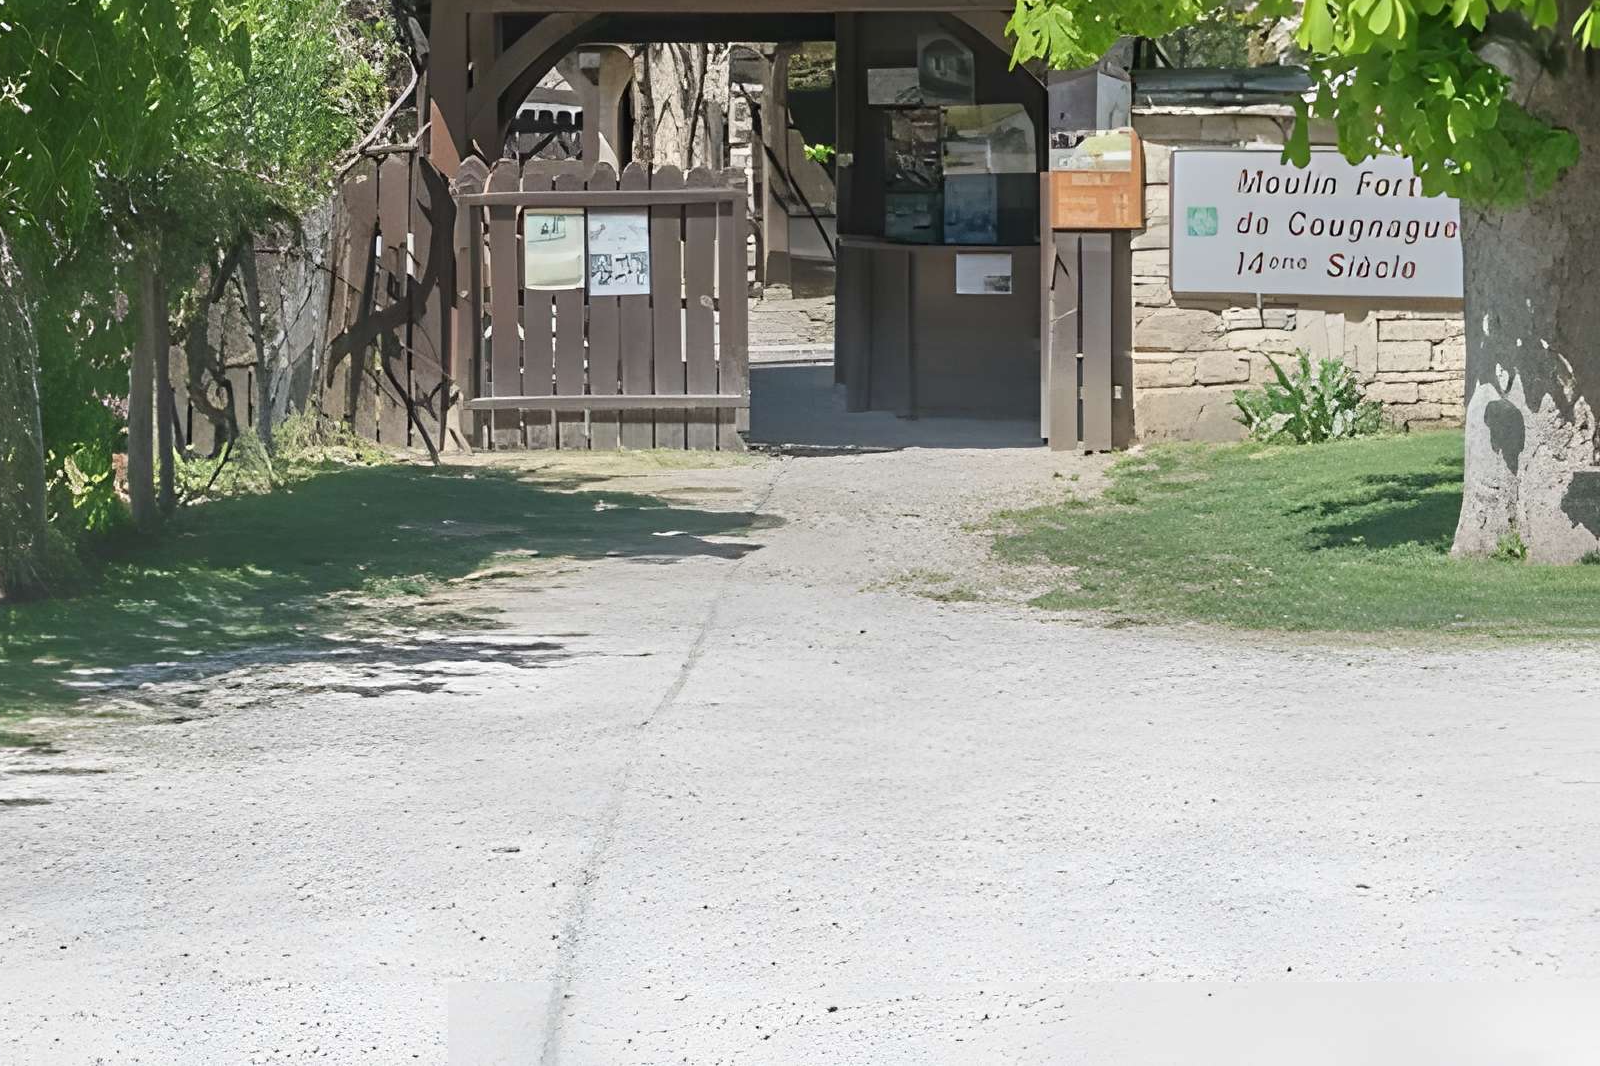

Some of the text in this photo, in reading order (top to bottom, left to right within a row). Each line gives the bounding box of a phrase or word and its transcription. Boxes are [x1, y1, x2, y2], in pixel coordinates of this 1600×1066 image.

[1237, 169, 1417, 197] Moulin Fort
[1288, 211, 1458, 245] Cougnague
